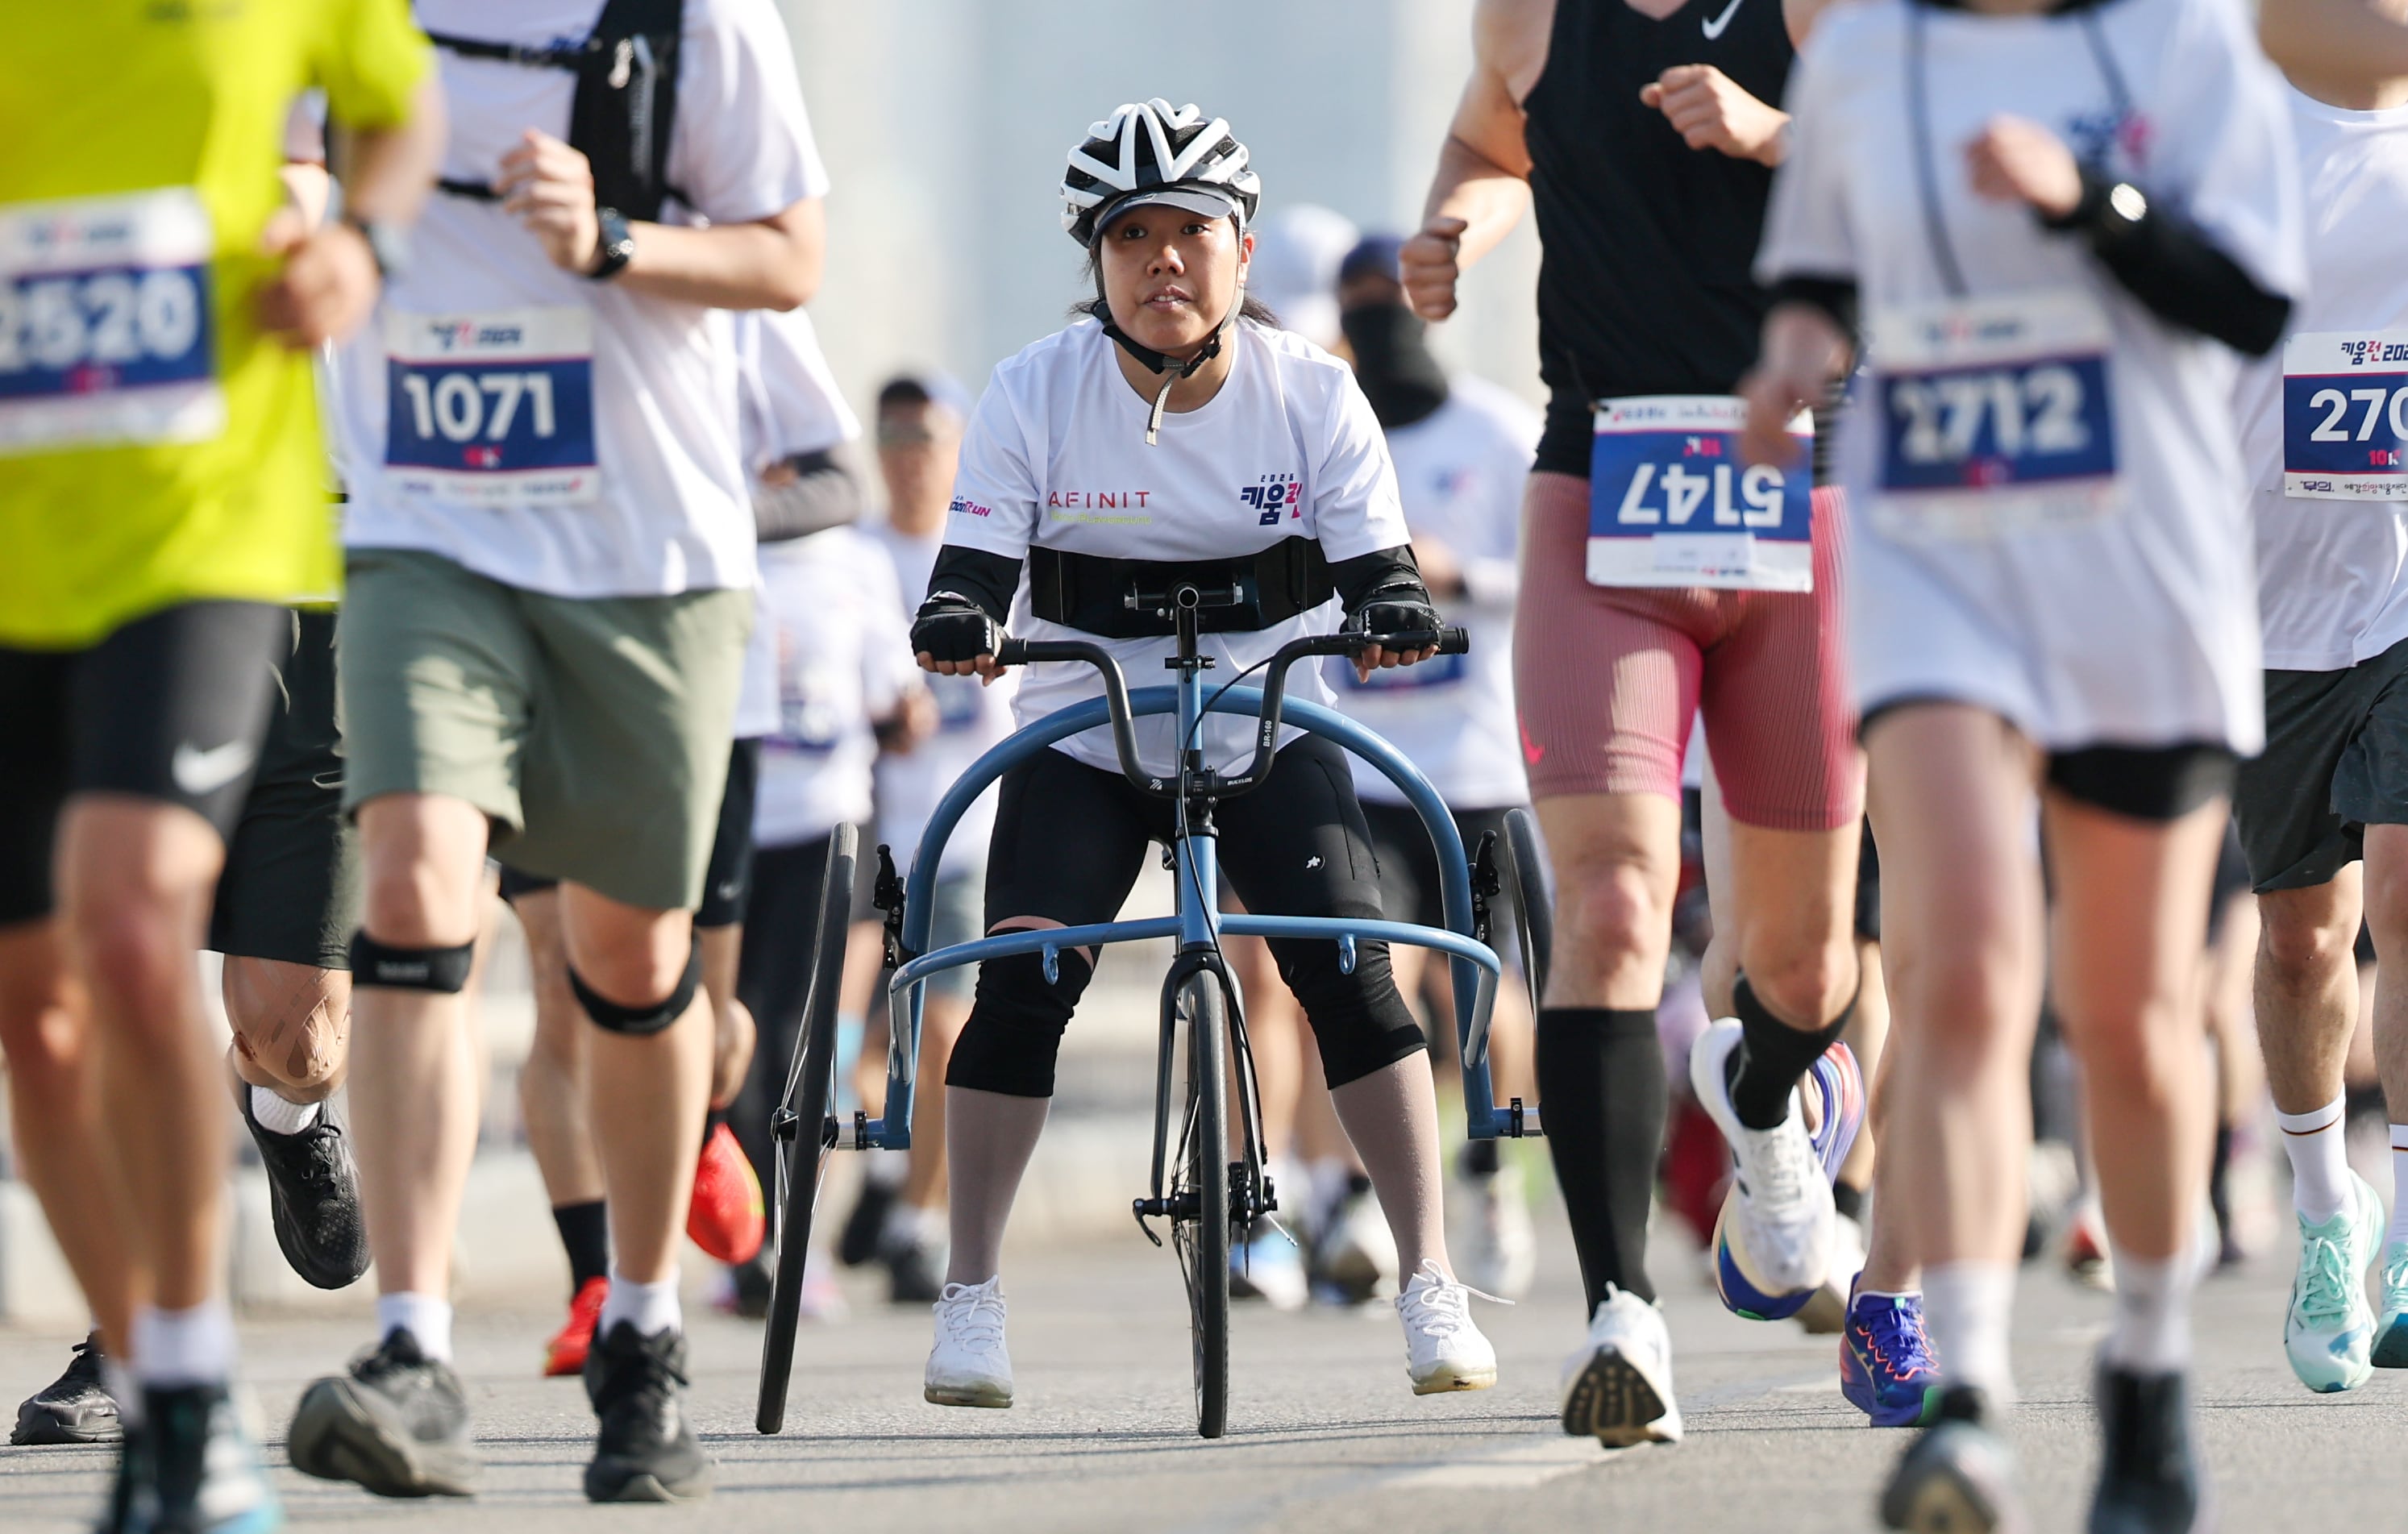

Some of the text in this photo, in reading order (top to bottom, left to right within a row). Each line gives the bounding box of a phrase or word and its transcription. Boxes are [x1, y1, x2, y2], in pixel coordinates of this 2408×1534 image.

[2341, 340, 2381, 365] 키움런
[405, 372, 555, 442] 1071
[1894, 366, 2090, 463] 2712
[2368, 449, 2402, 466] 10K
[1260, 472, 1294, 483] 2026
[1049, 491, 1150, 509] AFINIT
[1617, 463, 1785, 528] 5147
[1262, 720, 1272, 747] BR-160
